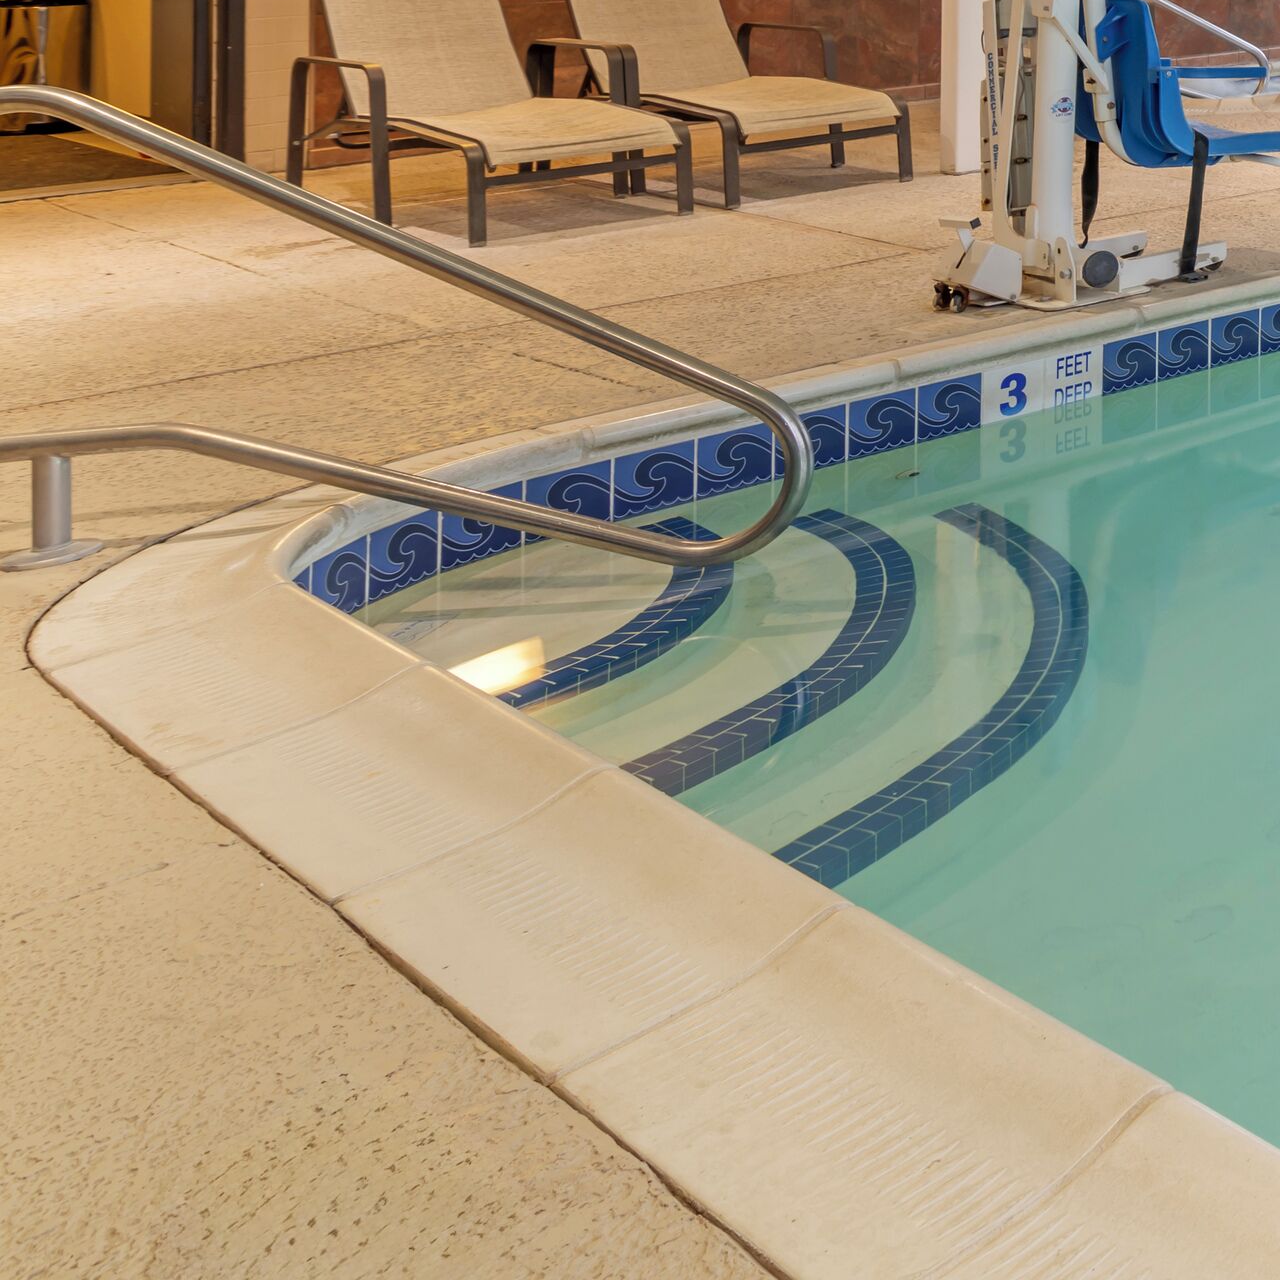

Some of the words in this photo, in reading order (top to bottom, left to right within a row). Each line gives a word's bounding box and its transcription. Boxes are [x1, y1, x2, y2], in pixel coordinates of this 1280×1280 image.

[1056, 351, 1092, 380] FEET
[1000, 373, 1027, 417] 3
[1054, 381, 1093, 406] DEEP
